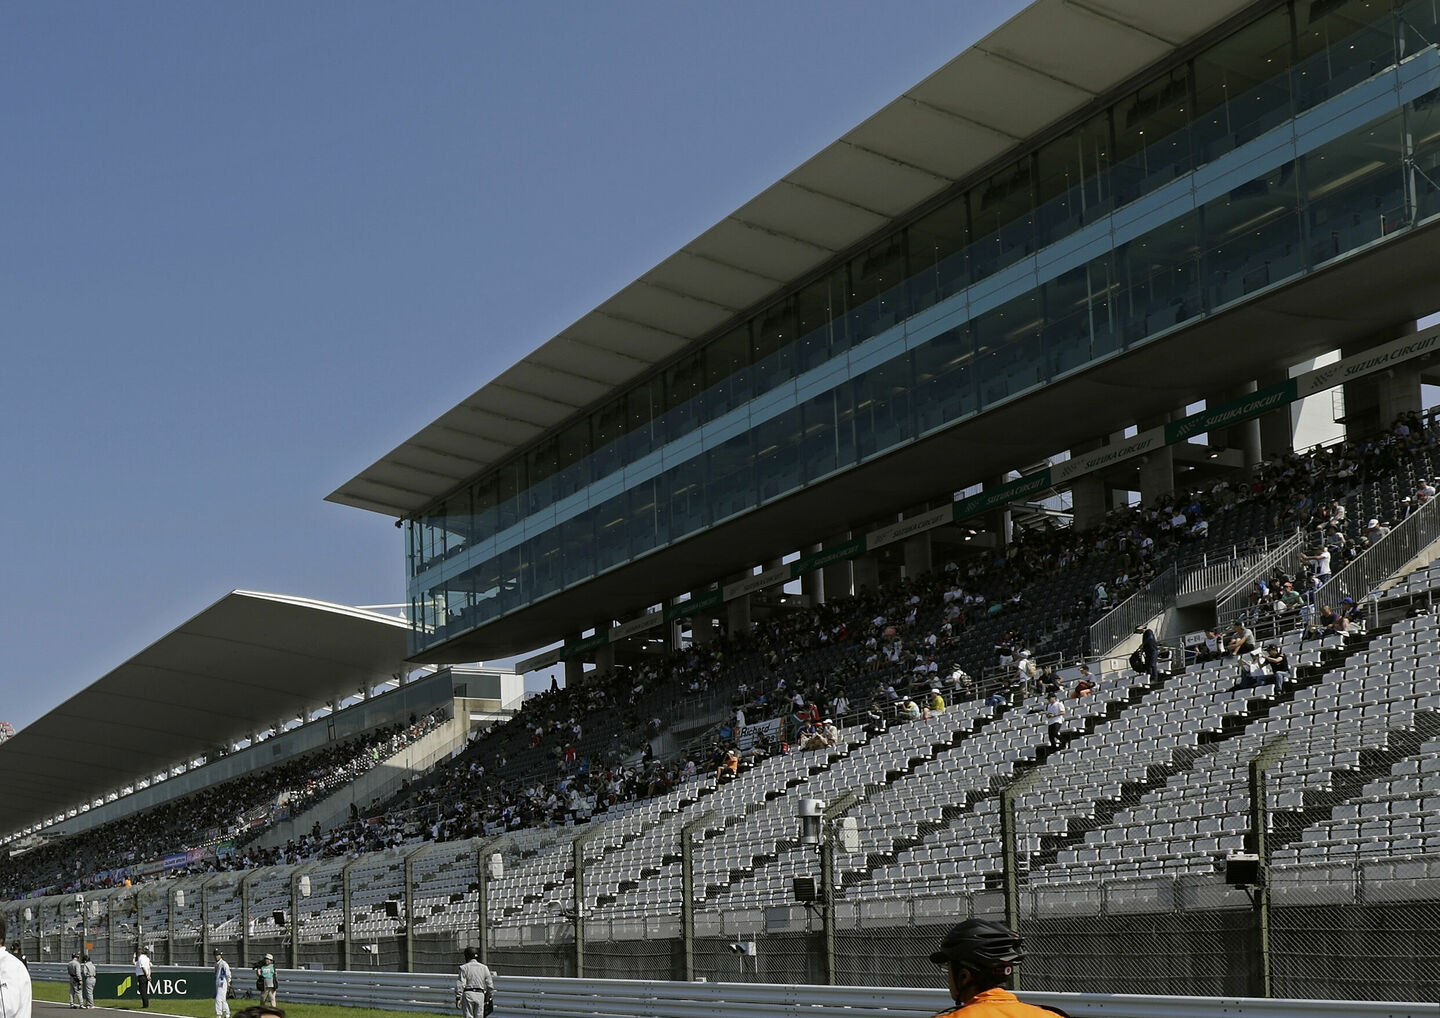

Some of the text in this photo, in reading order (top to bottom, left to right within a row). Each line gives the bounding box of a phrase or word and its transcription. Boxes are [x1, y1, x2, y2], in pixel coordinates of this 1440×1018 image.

[1344, 335, 1438, 377] SUZUKA CIRCUIT
[1205, 391, 1285, 427] SUZUKA CIRCUIT
[1085, 438, 1152, 469] SUZUKA CIRCUIT
